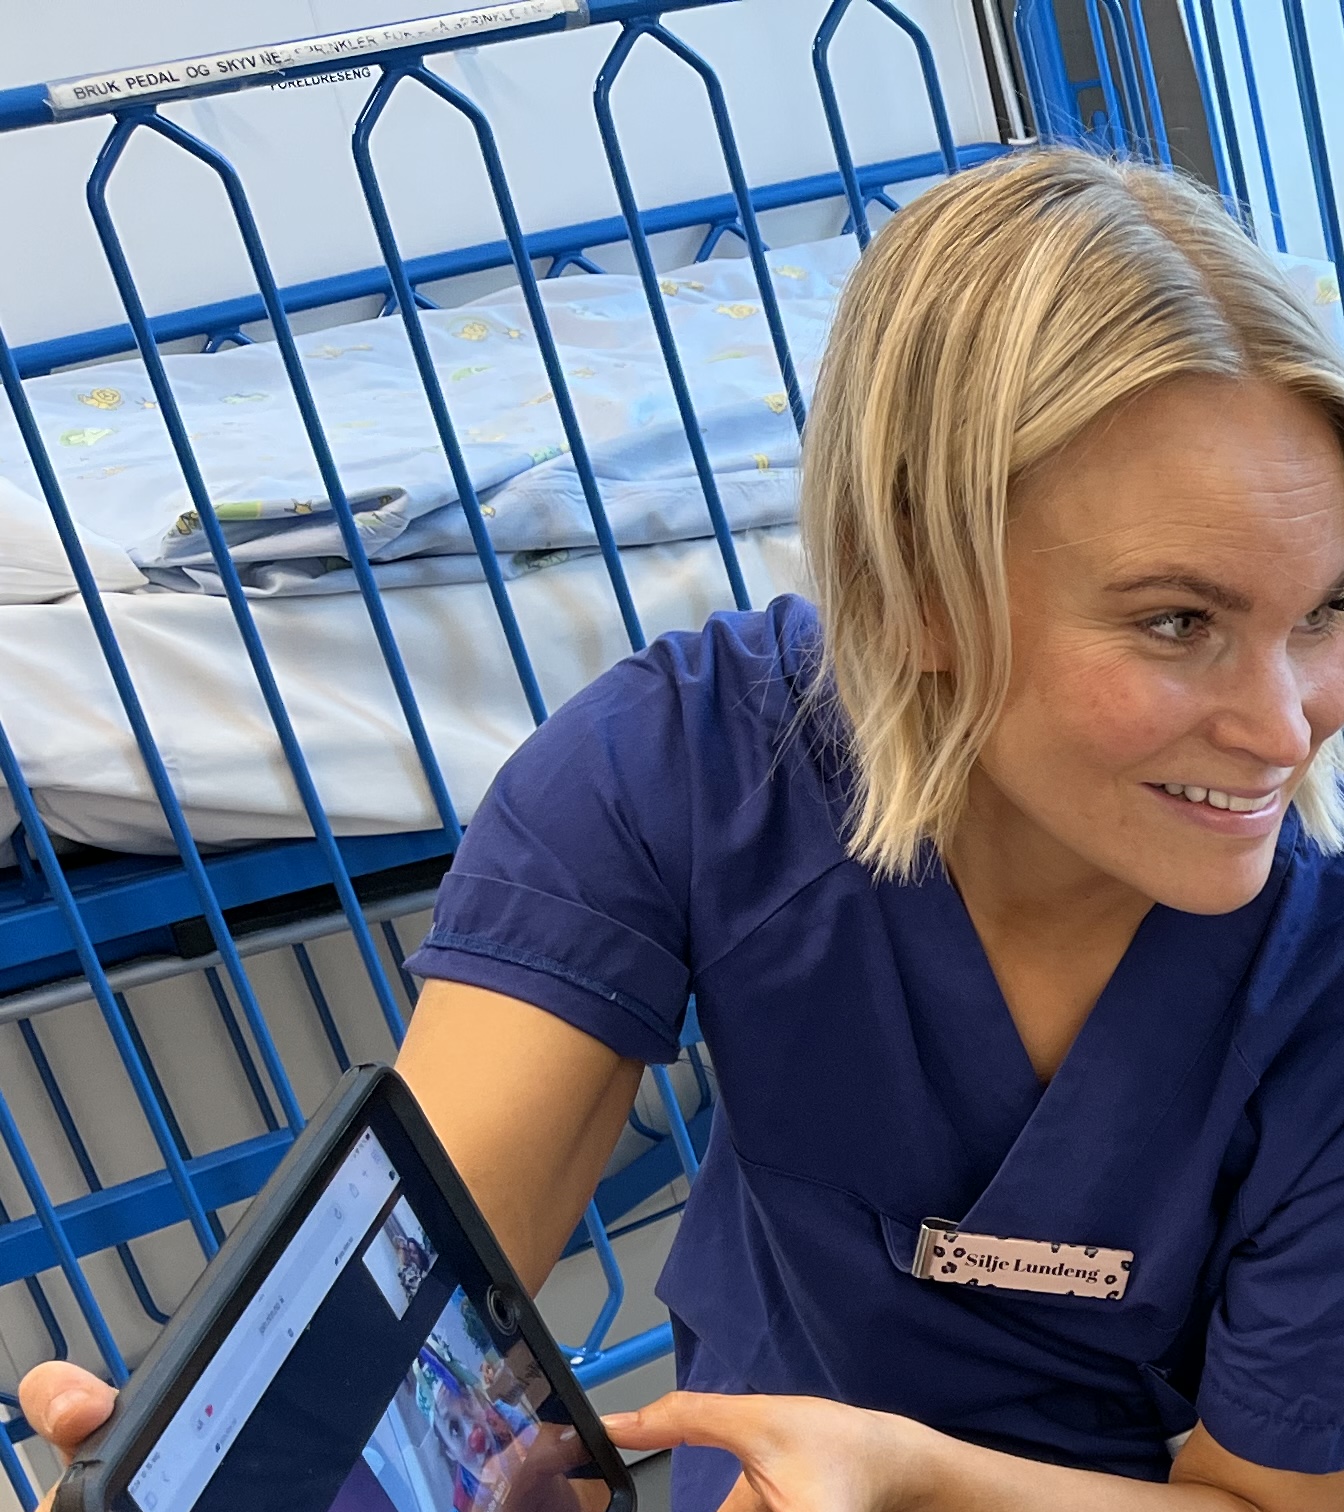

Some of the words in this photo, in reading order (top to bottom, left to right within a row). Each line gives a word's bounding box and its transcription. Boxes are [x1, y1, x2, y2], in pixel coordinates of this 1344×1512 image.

[74, 80, 121, 99] BRUK
[126, 70, 180, 90] PEDAL
[186, 64, 210, 79] OG
[217, 55, 256, 73] SKYV
[964, 1252, 1010, 1274] Silje
[1013, 1258, 1101, 1284] Lundeng
